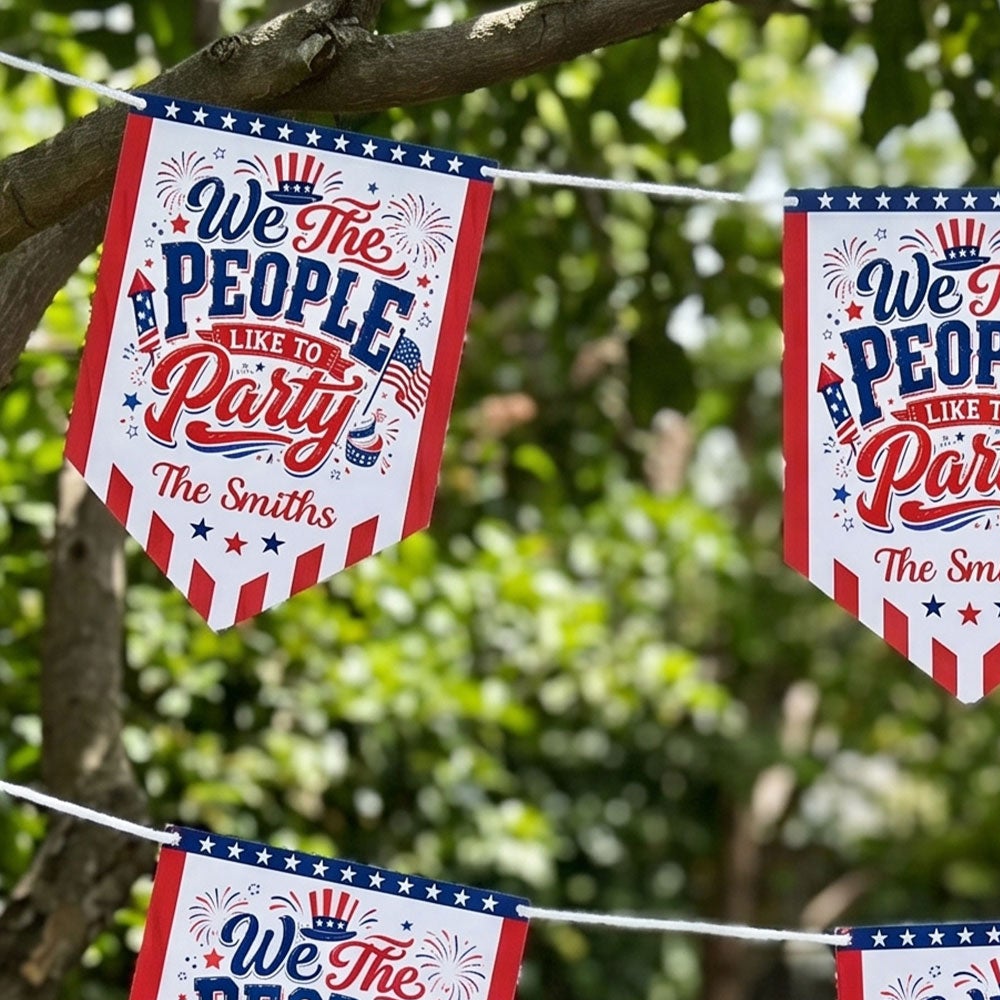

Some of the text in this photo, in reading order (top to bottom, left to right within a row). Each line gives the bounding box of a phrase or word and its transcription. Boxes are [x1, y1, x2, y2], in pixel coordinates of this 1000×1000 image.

[186, 177, 392, 264] We The
[161, 242, 414, 372] PEOPLE
[857, 252, 962, 324] We
[230, 328, 322, 363] LIKE TO
[144, 344, 364, 476] Party
[925, 399, 985, 424] LIKE
[153, 462, 337, 529] The Smiths
[874, 547, 937, 583] The
[221, 913, 425, 998] We The
